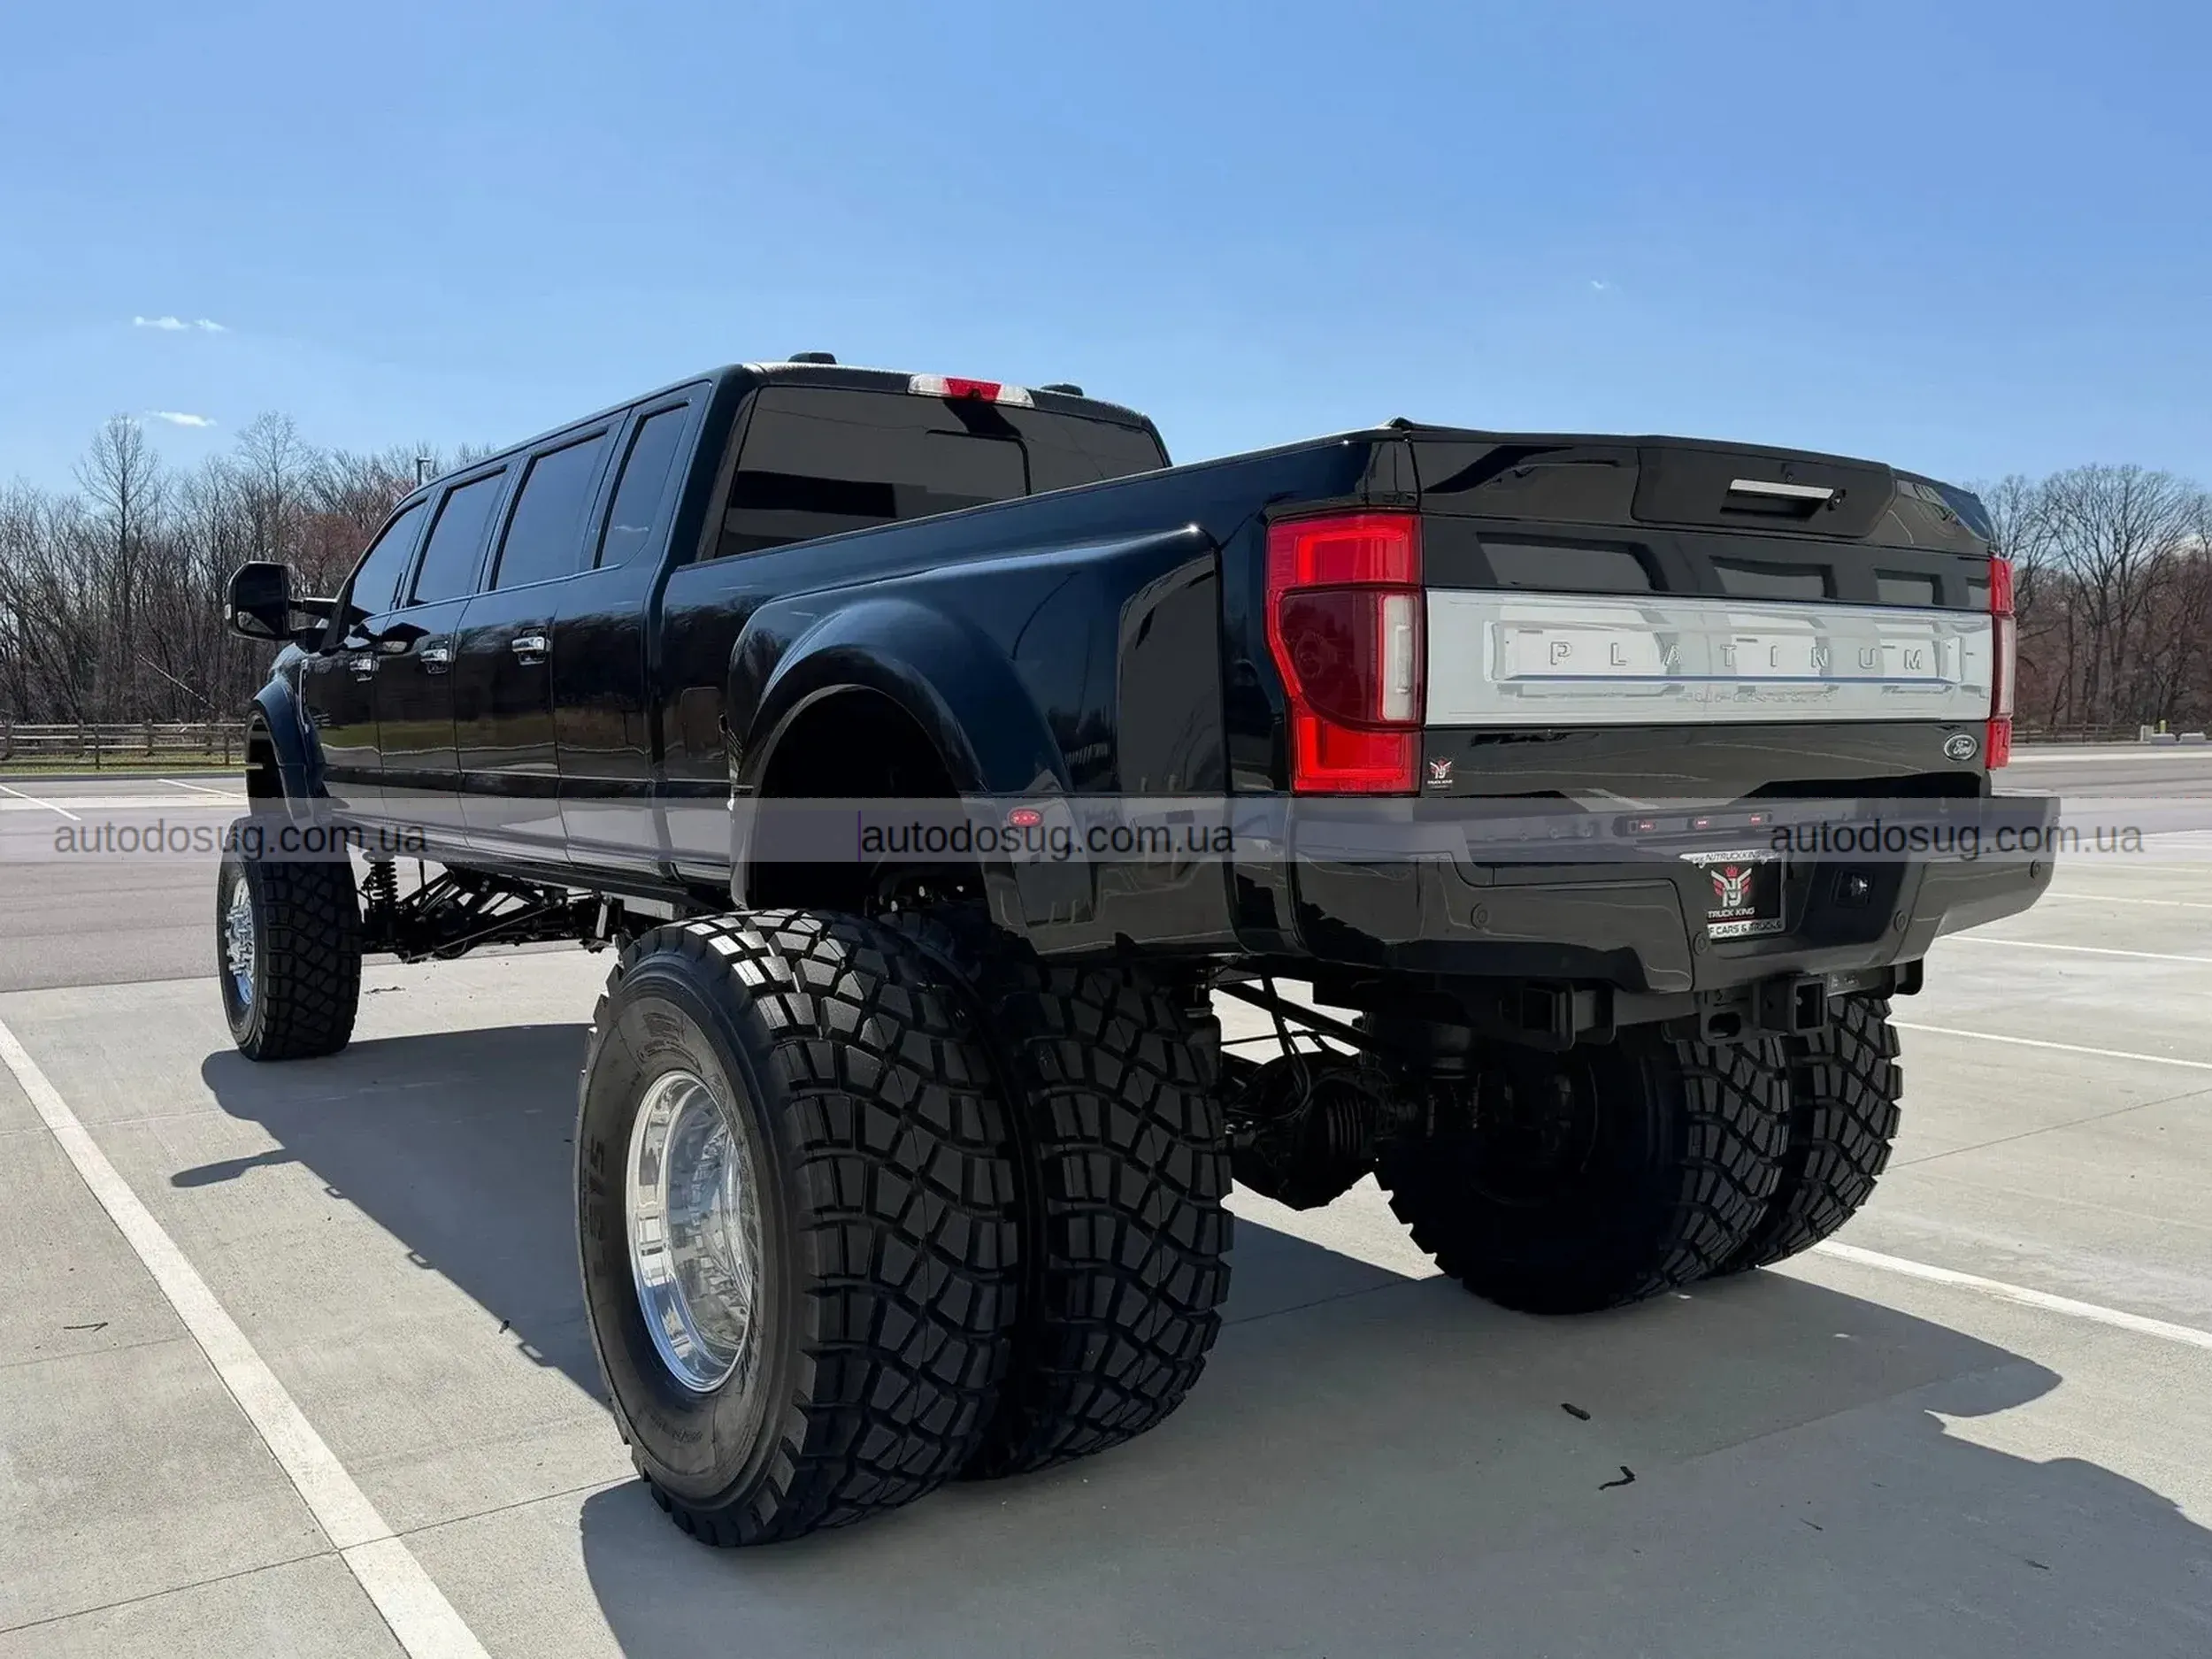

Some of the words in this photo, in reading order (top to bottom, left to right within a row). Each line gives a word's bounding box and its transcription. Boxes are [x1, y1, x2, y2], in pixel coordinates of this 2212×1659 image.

[1549, 641, 1922, 670] PLATINUM
[1708, 909, 1734, 918] TRUCK
[1735, 907, 1755, 916] KING
[1716, 924, 1740, 934] CARS
